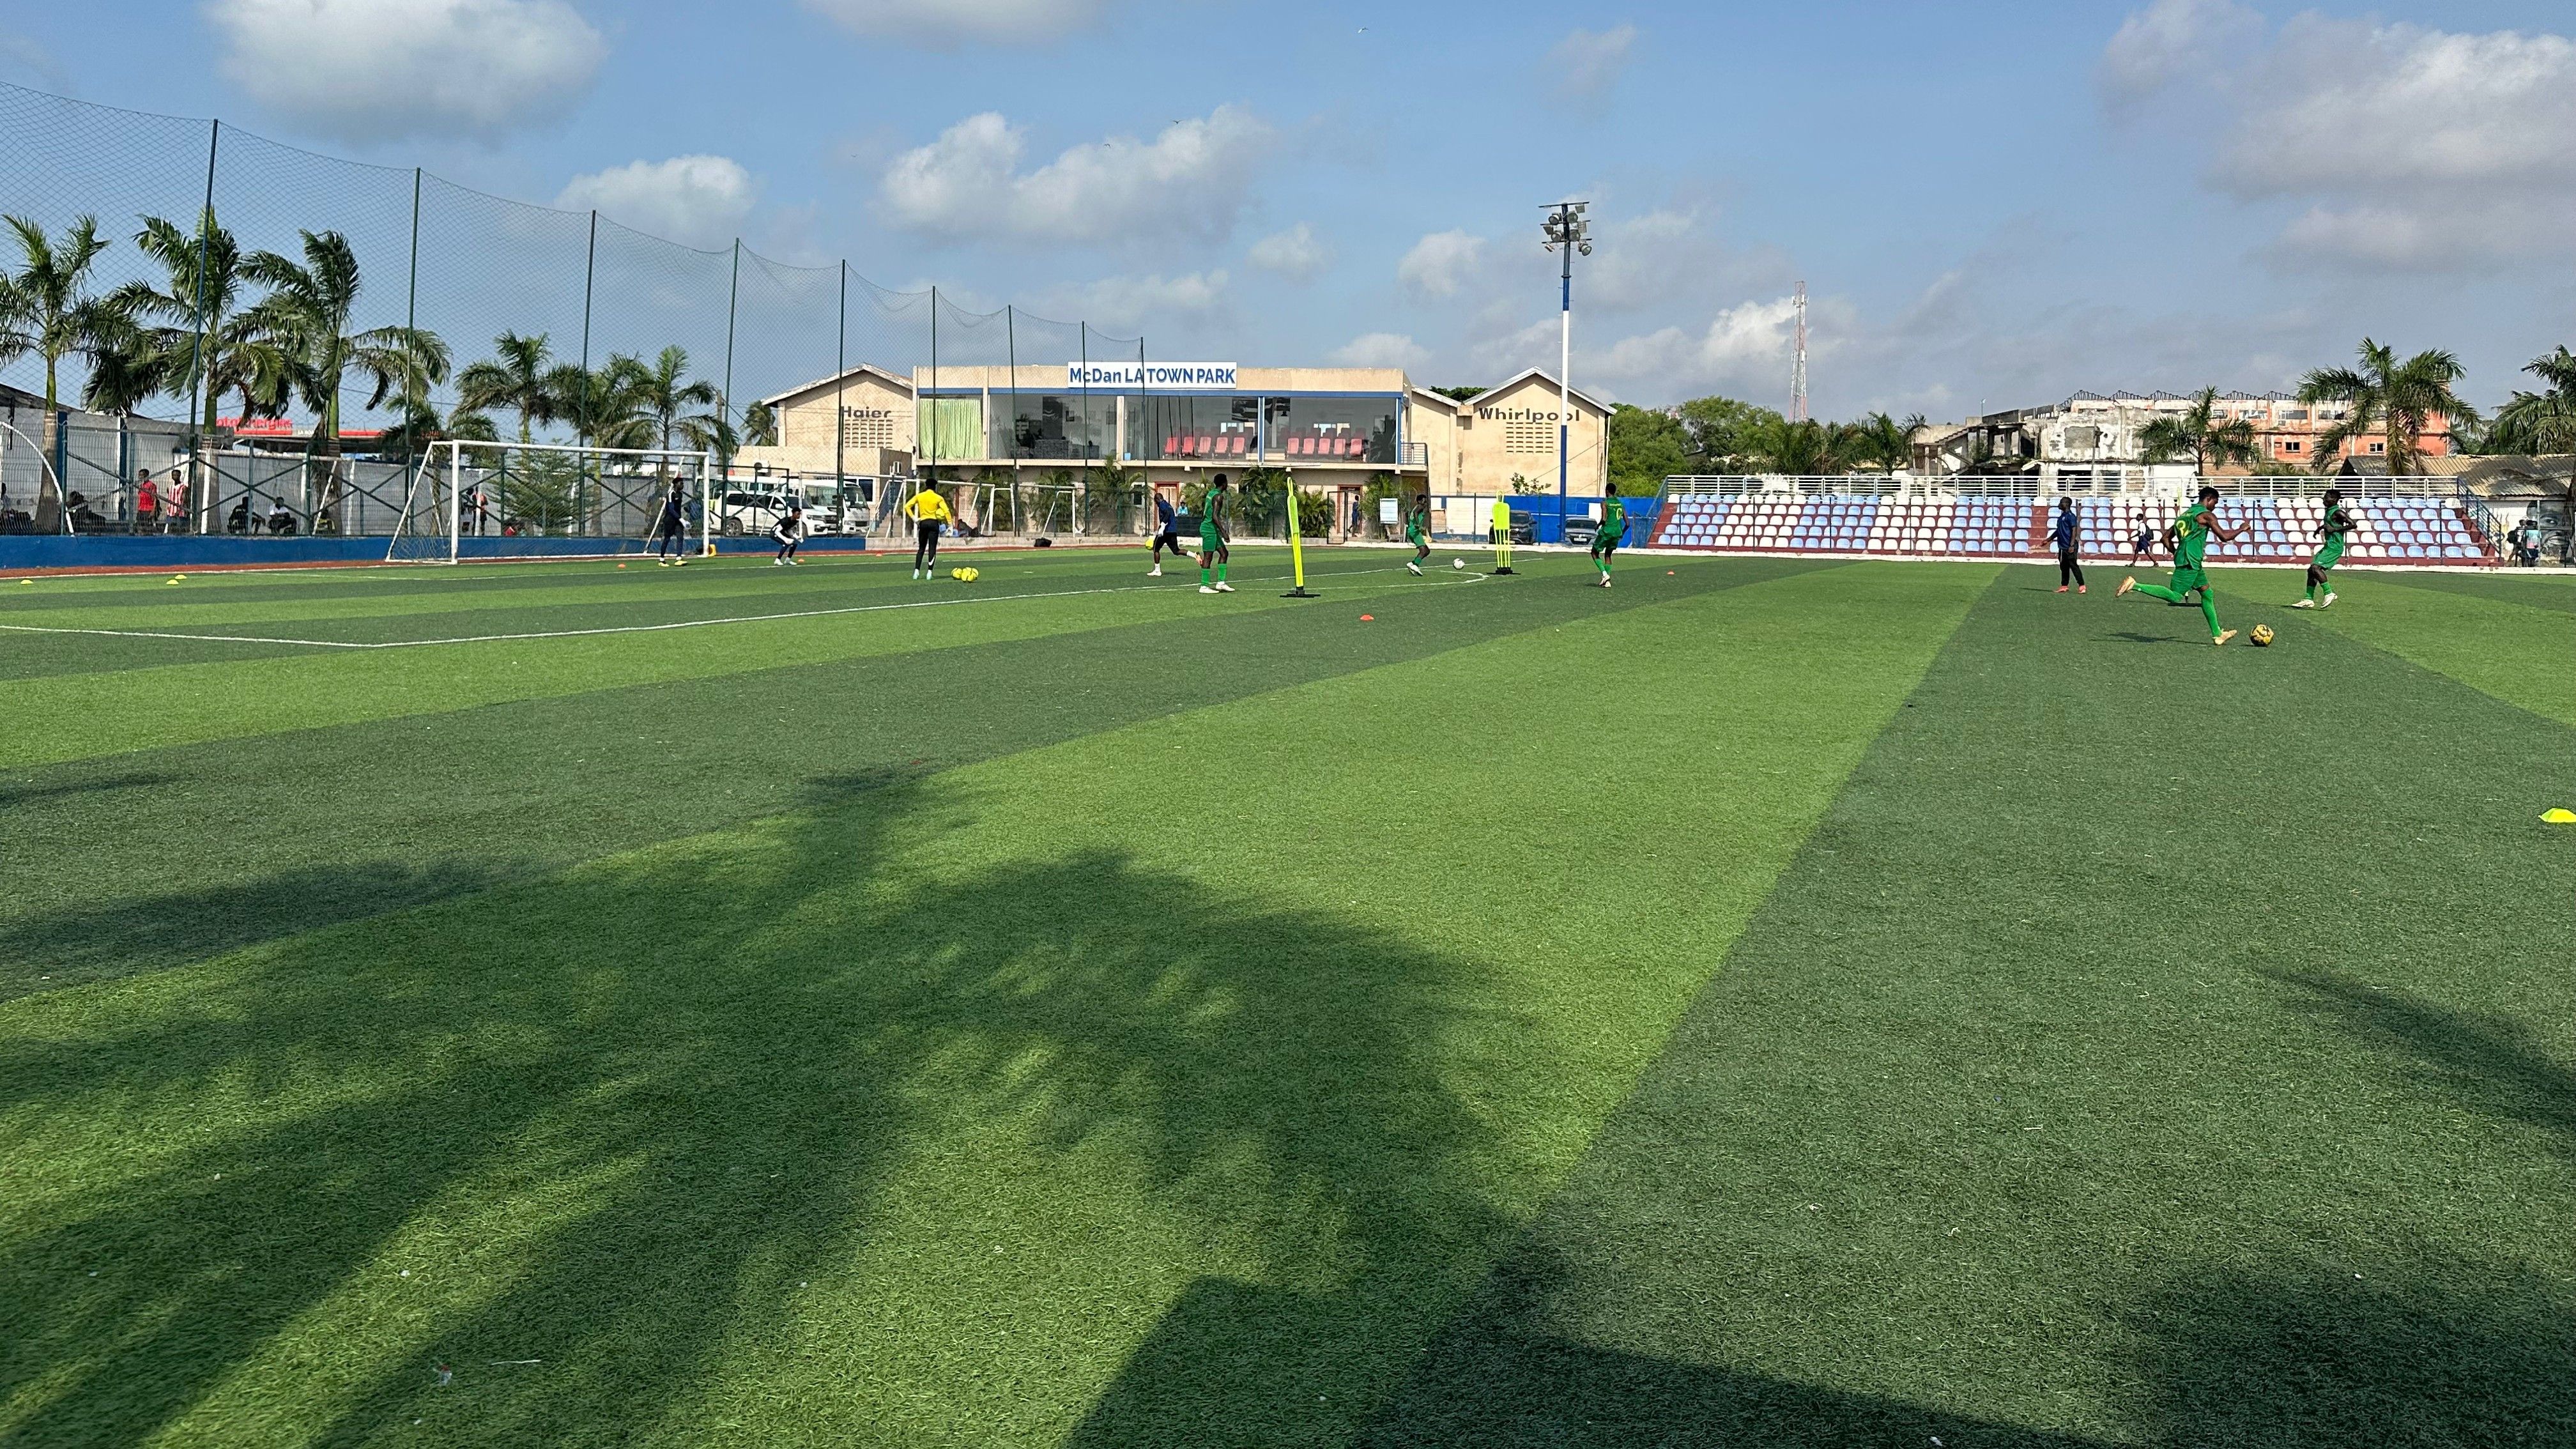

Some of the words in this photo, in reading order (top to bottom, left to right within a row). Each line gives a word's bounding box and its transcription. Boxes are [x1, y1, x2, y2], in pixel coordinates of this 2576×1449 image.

[1070, 367, 1121, 383] McDan
[1125, 368, 1143, 383] LA
[1146, 368, 1193, 384] TOWN
[1197, 368, 1236, 384] PARK
[841, 406, 892, 418] Haier
